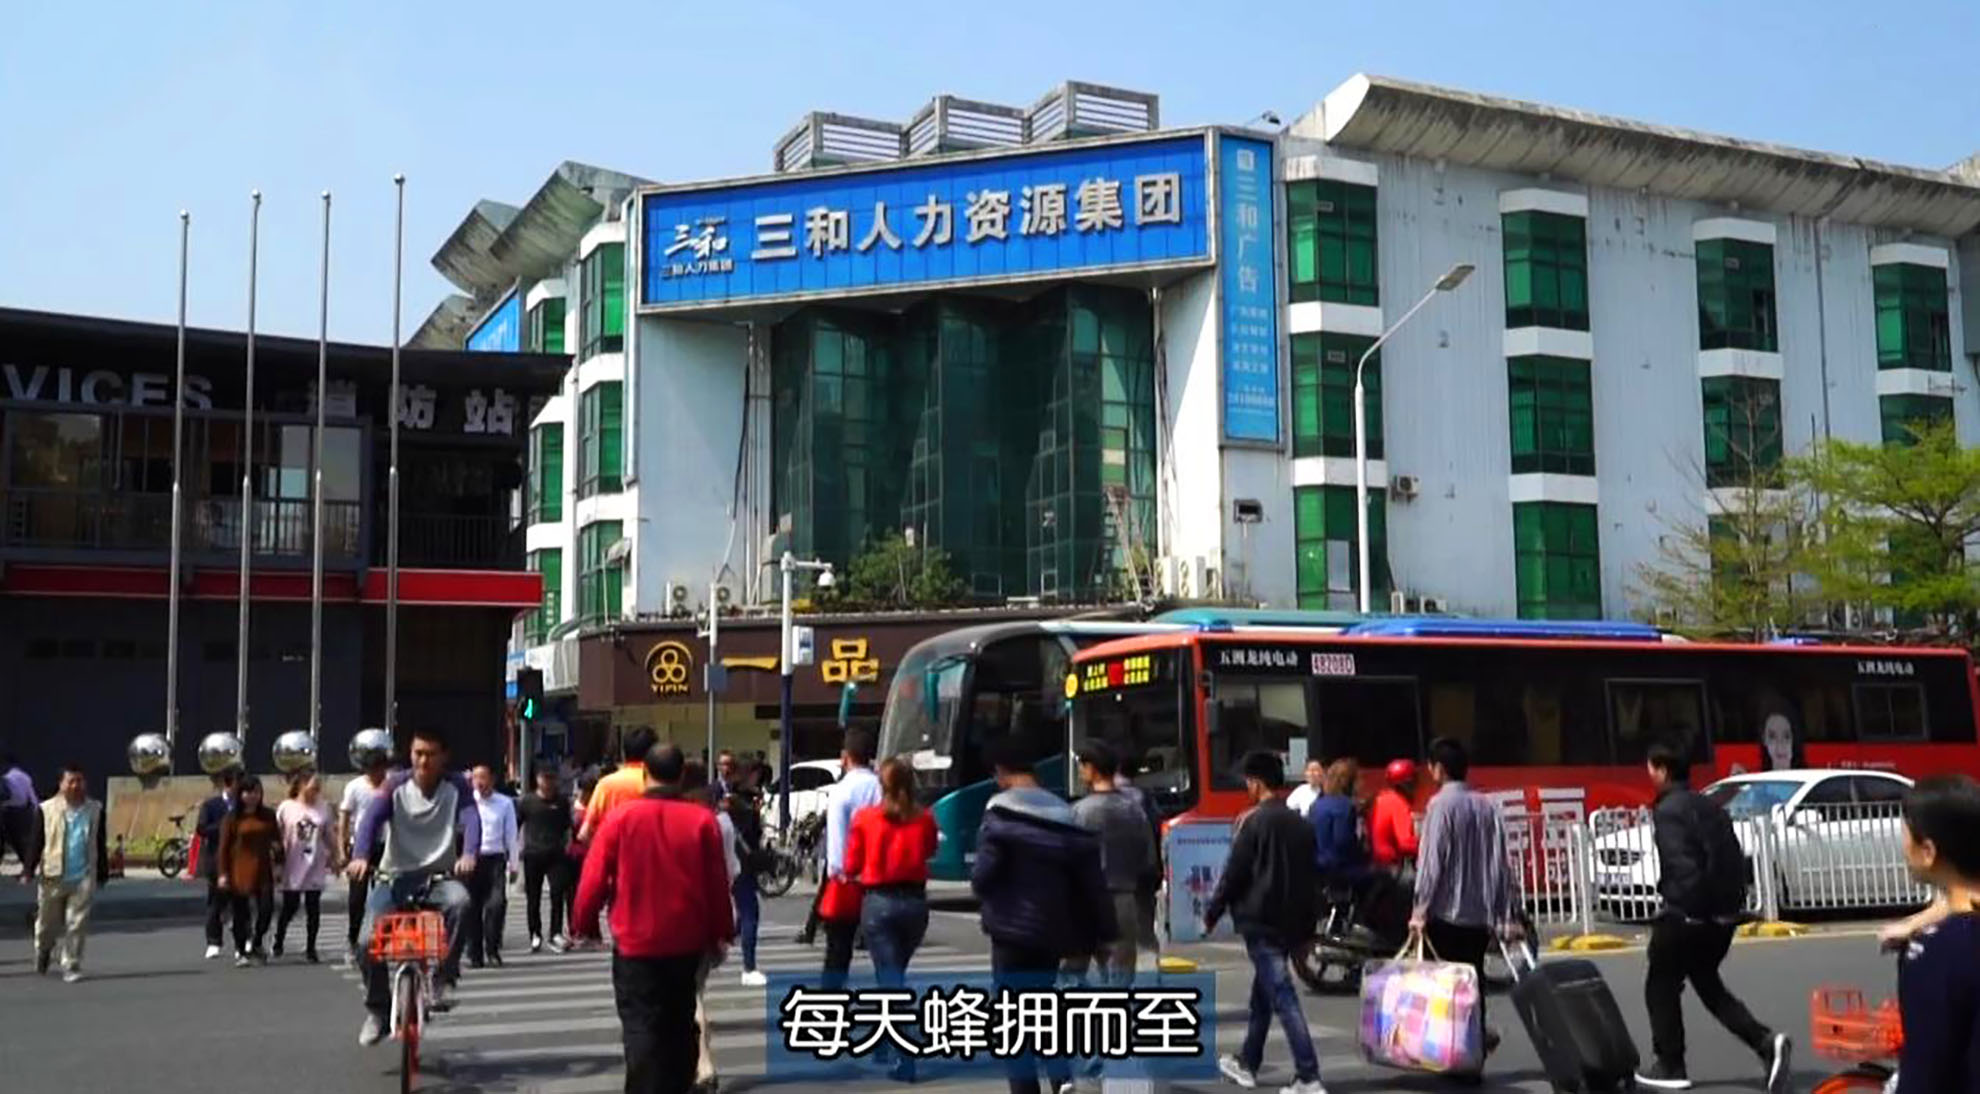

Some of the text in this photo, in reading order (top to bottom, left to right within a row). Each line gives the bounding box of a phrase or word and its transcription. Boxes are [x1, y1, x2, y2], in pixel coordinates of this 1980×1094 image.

[751, 172, 1182, 261] 三和人力资源集团
